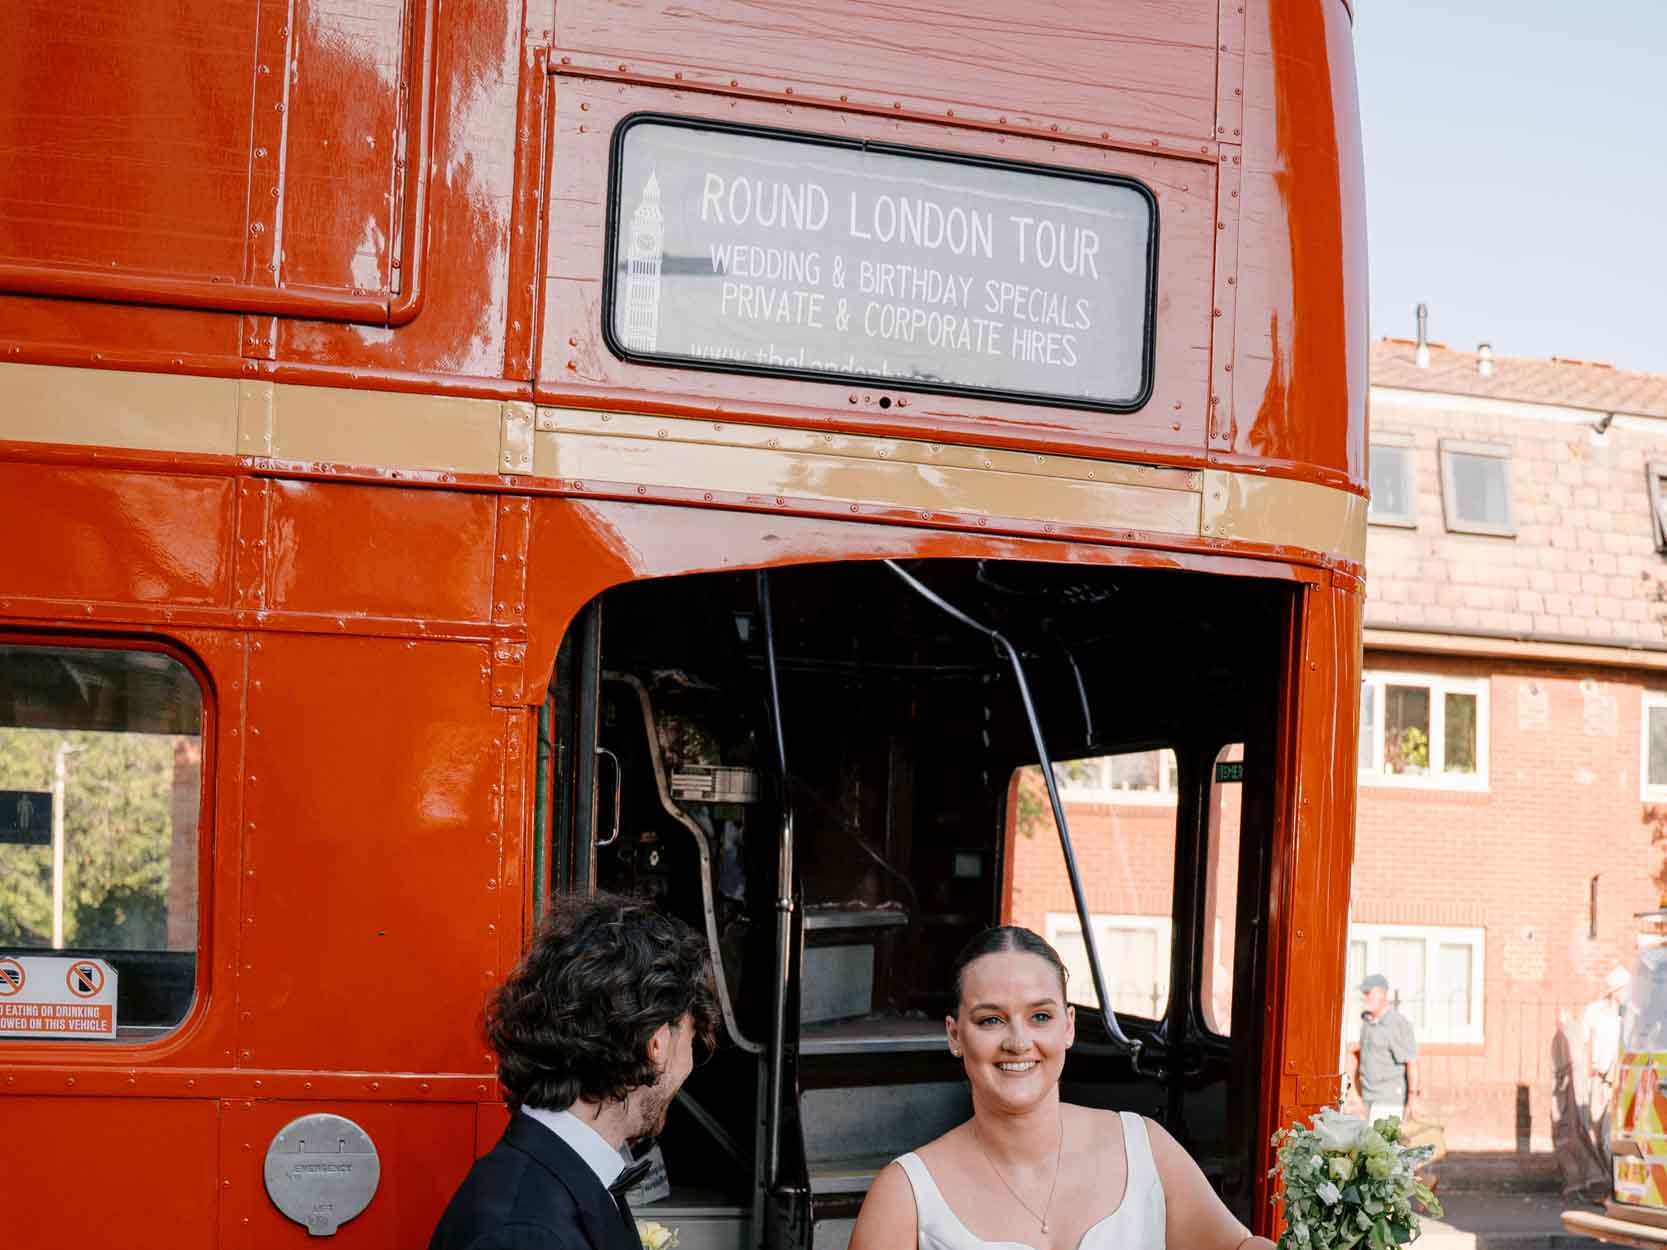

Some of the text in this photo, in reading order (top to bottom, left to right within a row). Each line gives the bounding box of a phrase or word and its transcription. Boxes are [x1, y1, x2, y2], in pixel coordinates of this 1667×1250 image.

[701, 172, 1100, 280] ROUND LONDON TOUR
[709, 242, 1091, 330] WEDDING & BIRTHDAY SPECIALS
[721, 280, 1078, 368] PRIVATE & CORPORATE HIRES
[6, 1004, 39, 1017] EATING
[41, 1005, 53, 1017] OR
[56, 1006, 99, 1018] DRINKING
[29, 1018, 42, 1030] ON
[46, 1018, 65, 1030] THIS
[69, 1018, 108, 1031] VEHICLE
